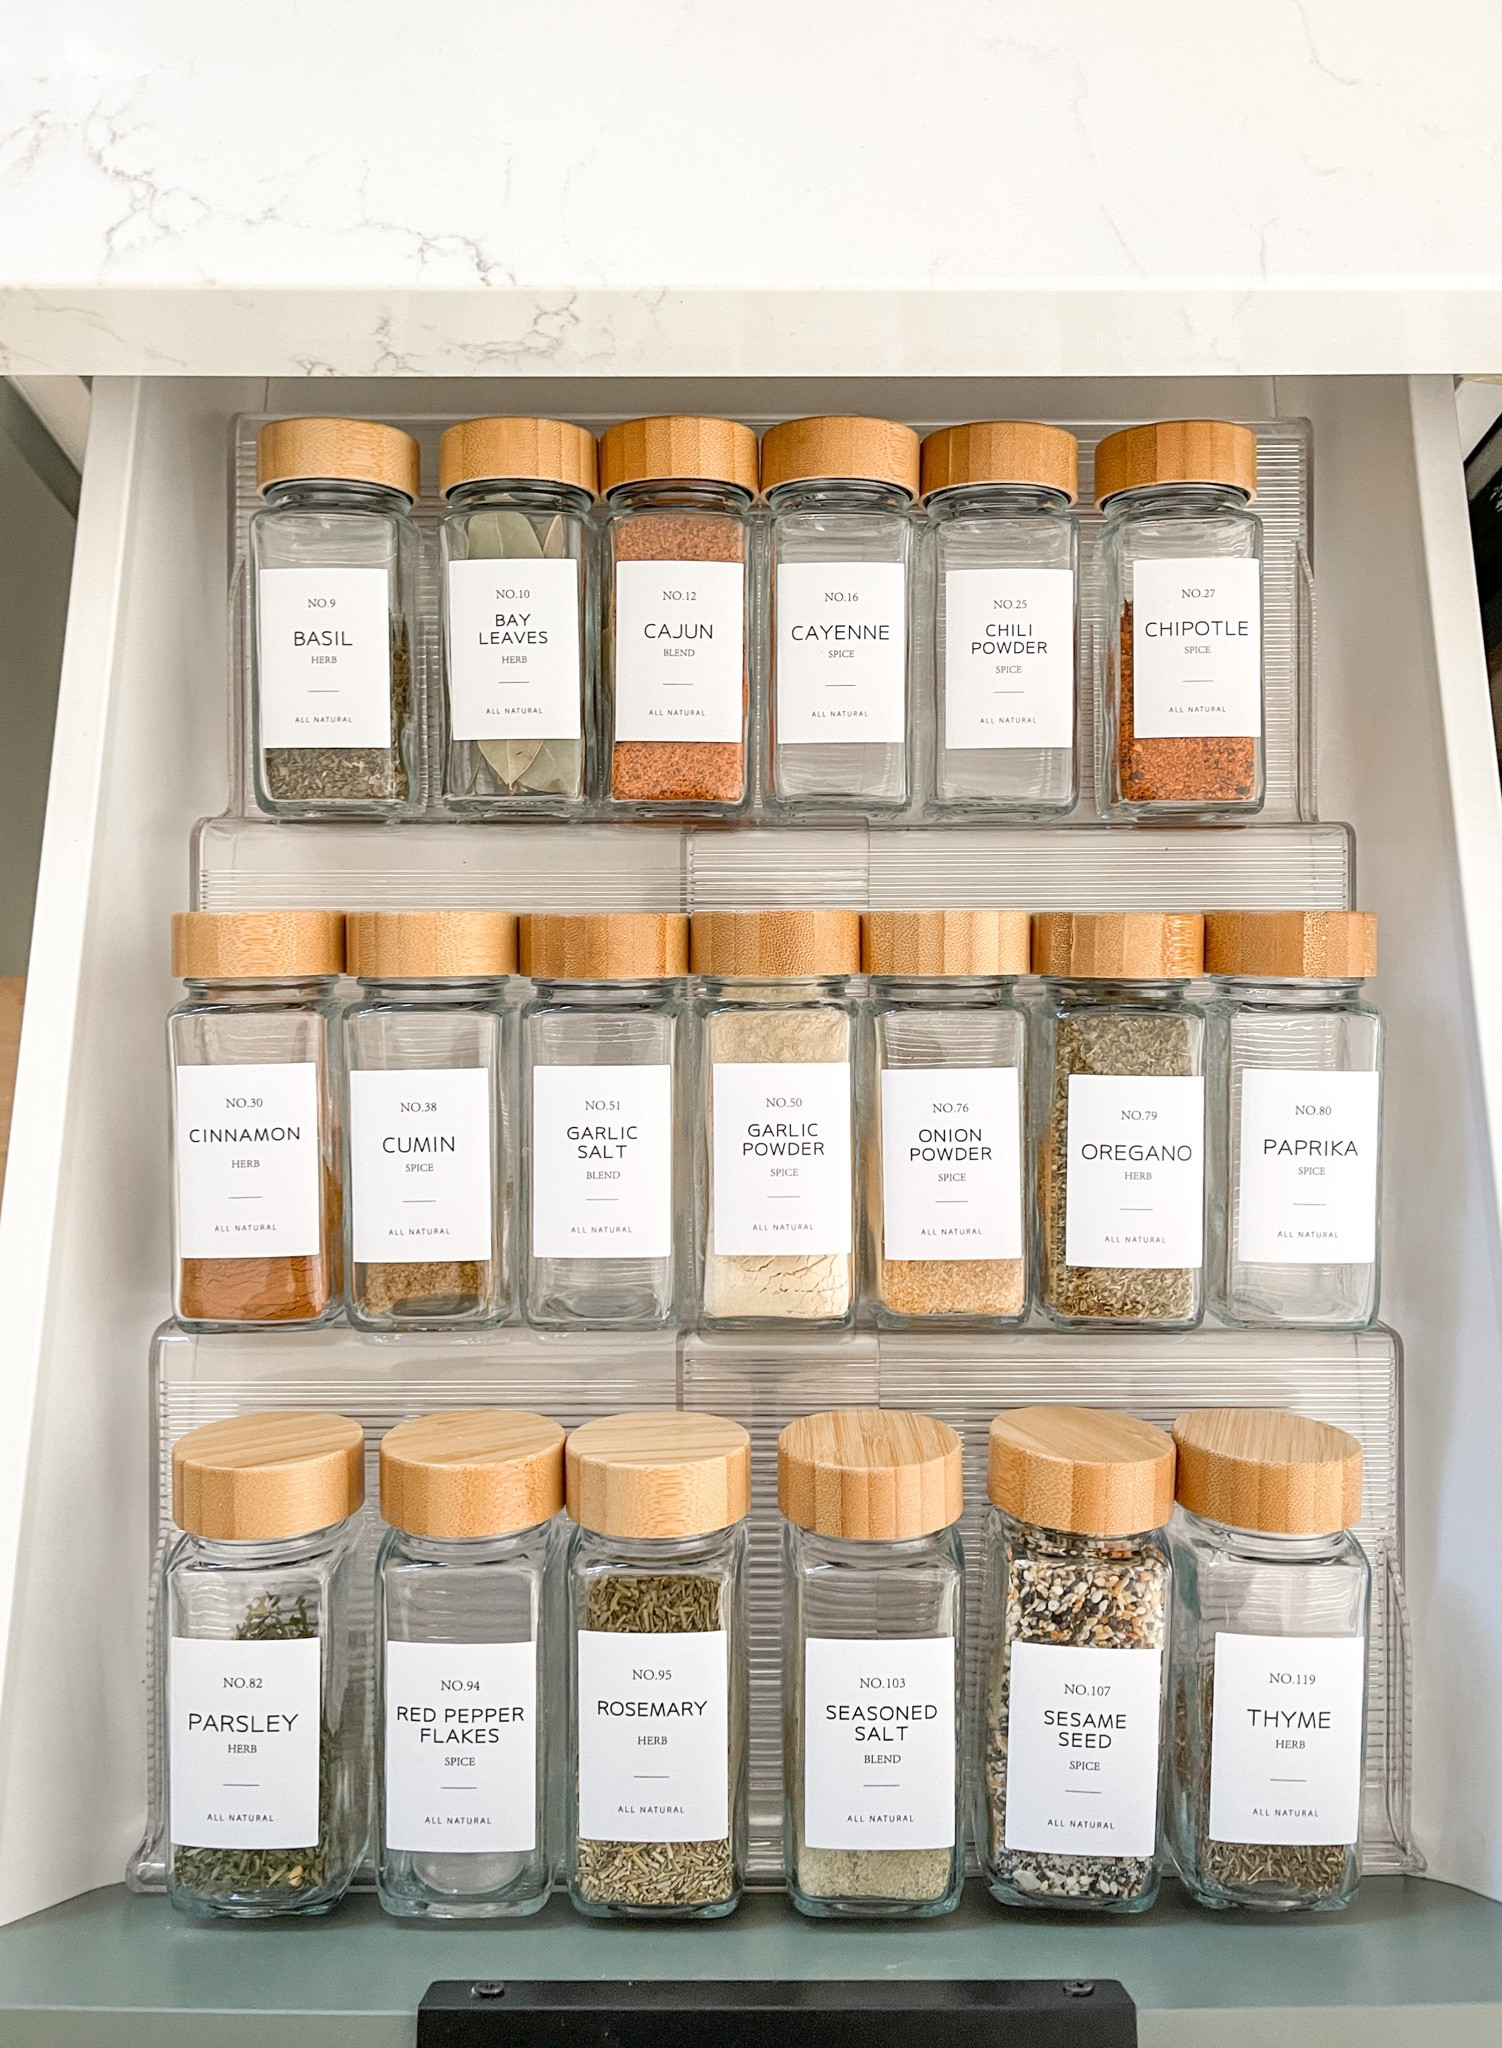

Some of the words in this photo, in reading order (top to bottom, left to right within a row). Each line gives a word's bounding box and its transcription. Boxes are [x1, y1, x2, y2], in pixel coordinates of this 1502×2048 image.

[495, 588, 531, 600] NO.10
[662, 590, 697, 602] NO.12
[824, 591, 859, 603] NO.16
[1181, 588, 1216, 599] NO.27
[307, 597, 337, 609] NO.9
[992, 599, 1028, 610] NO.25
[494, 613, 532, 628] BAY
[643, 622, 714, 640] CAJUN
[790, 624, 890, 642] CAYENNE
[985, 623, 1033, 638] CHILI
[1144, 620, 1249, 638] CHIPOTLE
[293, 630, 354, 647] BASIL
[478, 630, 549, 646] LEAVES
[663, 648, 696, 658] BLEND
[827, 649, 855, 659] SPICE
[971, 640, 1048, 656] POWDER
[1183, 645, 1212, 655] SPICE
[310, 655, 338, 665] HERB
[501, 655, 528, 665] HERB
[995, 665, 1023, 675] SPICE
[485, 707, 501, 715] ALL
[504, 706, 543, 715] NATURAL
[648, 708, 664, 717] ALL
[666, 708, 706, 717] NATURAL
[811, 710, 827, 718] ALL
[829, 710, 869, 718] NATURAL
[1168, 706, 1185, 714] ALL
[1187, 705, 1227, 713] NATURAL
[294, 716, 310, 724] ALL
[313, 715, 353, 724] NATURAL
[979, 717, 995, 725] ALL
[998, 716, 1037, 724] NATURAL
[224, 1097, 264, 1109] NO.30
[399, 1101, 438, 1113] NO.38
[584, 1099, 621, 1111] NO.51
[765, 1096, 803, 1109] NO.50
[931, 1102, 970, 1114] NO.76
[1120, 1109, 1158, 1121] NO.79
[1295, 1104, 1332, 1116] NO.80
[188, 1126, 301, 1144] CINNAMON
[566, 1125, 639, 1141] GARLIC
[747, 1122, 819, 1138] GARLIC
[918, 1128, 982, 1144] ONION
[382, 1135, 456, 1154] CUMIN
[742, 1141, 825, 1157] POWDER
[1263, 1138, 1359, 1157] PAPRIKA
[577, 1144, 628, 1160] SALT
[909, 1146, 993, 1162] POWDER
[1080, 1143, 1193, 1162] OREGANO
[231, 1159, 261, 1169] HERB
[405, 1162, 435, 1173] SPICE
[585, 1170, 621, 1180] BLEND
[770, 1167, 799, 1178] SPICE
[1124, 1171, 1153, 1181] HERB
[1297, 1166, 1326, 1176] SPICE
[937, 1172, 967, 1183] SPICE
[214, 1225, 231, 1233] ALL
[234, 1223, 278, 1232] NATURAL
[388, 1228, 405, 1237] ALL
[408, 1227, 451, 1236] NATURAL
[570, 1226, 587, 1234] ALL
[590, 1225, 633, 1234] NATURAL
[752, 1223, 769, 1232] ALL
[772, 1223, 814, 1232] NATURAL
[920, 1228, 937, 1236] ALL
[940, 1227, 983, 1236] NATURAL
[1104, 1235, 1121, 1244] ALL
[1124, 1235, 1166, 1244] NATURAL
[1277, 1230, 1294, 1239] ALL
[1297, 1230, 1339, 1239] NATURAL
[631, 1668, 673, 1681] NO.95
[1268, 1672, 1316, 1686] NO.119
[222, 1676, 264, 1689] NO.82
[440, 1679, 481, 1692] NO.94
[858, 1676, 906, 1690] NO.103
[1063, 1682, 1112, 1697] NO.107
[396, 1705, 437, 1723] RED
[444, 1706, 525, 1724] PEPPER
[597, 1699, 709, 1718] ROSEMARY
[823, 1704, 938, 1722] SEASONED
[188, 1712, 300, 1734] PARSLEY
[1043, 1709, 1127, 1730] SESAME
[1245, 1708, 1332, 1730] THYME
[418, 1727, 500, 1745] FLAKES
[854, 1725, 909, 1742] SALT
[637, 1735, 668, 1746] HERB
[1057, 1730, 1112, 1750] SEED
[1274, 1738, 1306, 1750] HERB
[227, 1743, 258, 1754] HERB
[444, 1756, 477, 1767] SPICE
[863, 1754, 902, 1765] BLEND
[1068, 1760, 1101, 1772] SPICE
[617, 1805, 636, 1814] ALL
[639, 1805, 685, 1815] NATURAL
[1252, 1807, 1270, 1817] ALL
[1274, 1808, 1320, 1818] NATURAL
[206, 1813, 225, 1822] ALL
[228, 1813, 275, 1823] NATURAL
[424, 1816, 443, 1825] ALL
[446, 1816, 492, 1826] NATURAL
[846, 1814, 865, 1823] ALL
[868, 1814, 915, 1824] NATURAL
[1046, 1818, 1065, 1828] ALL
[1069, 1819, 1116, 1830] NATURAL
